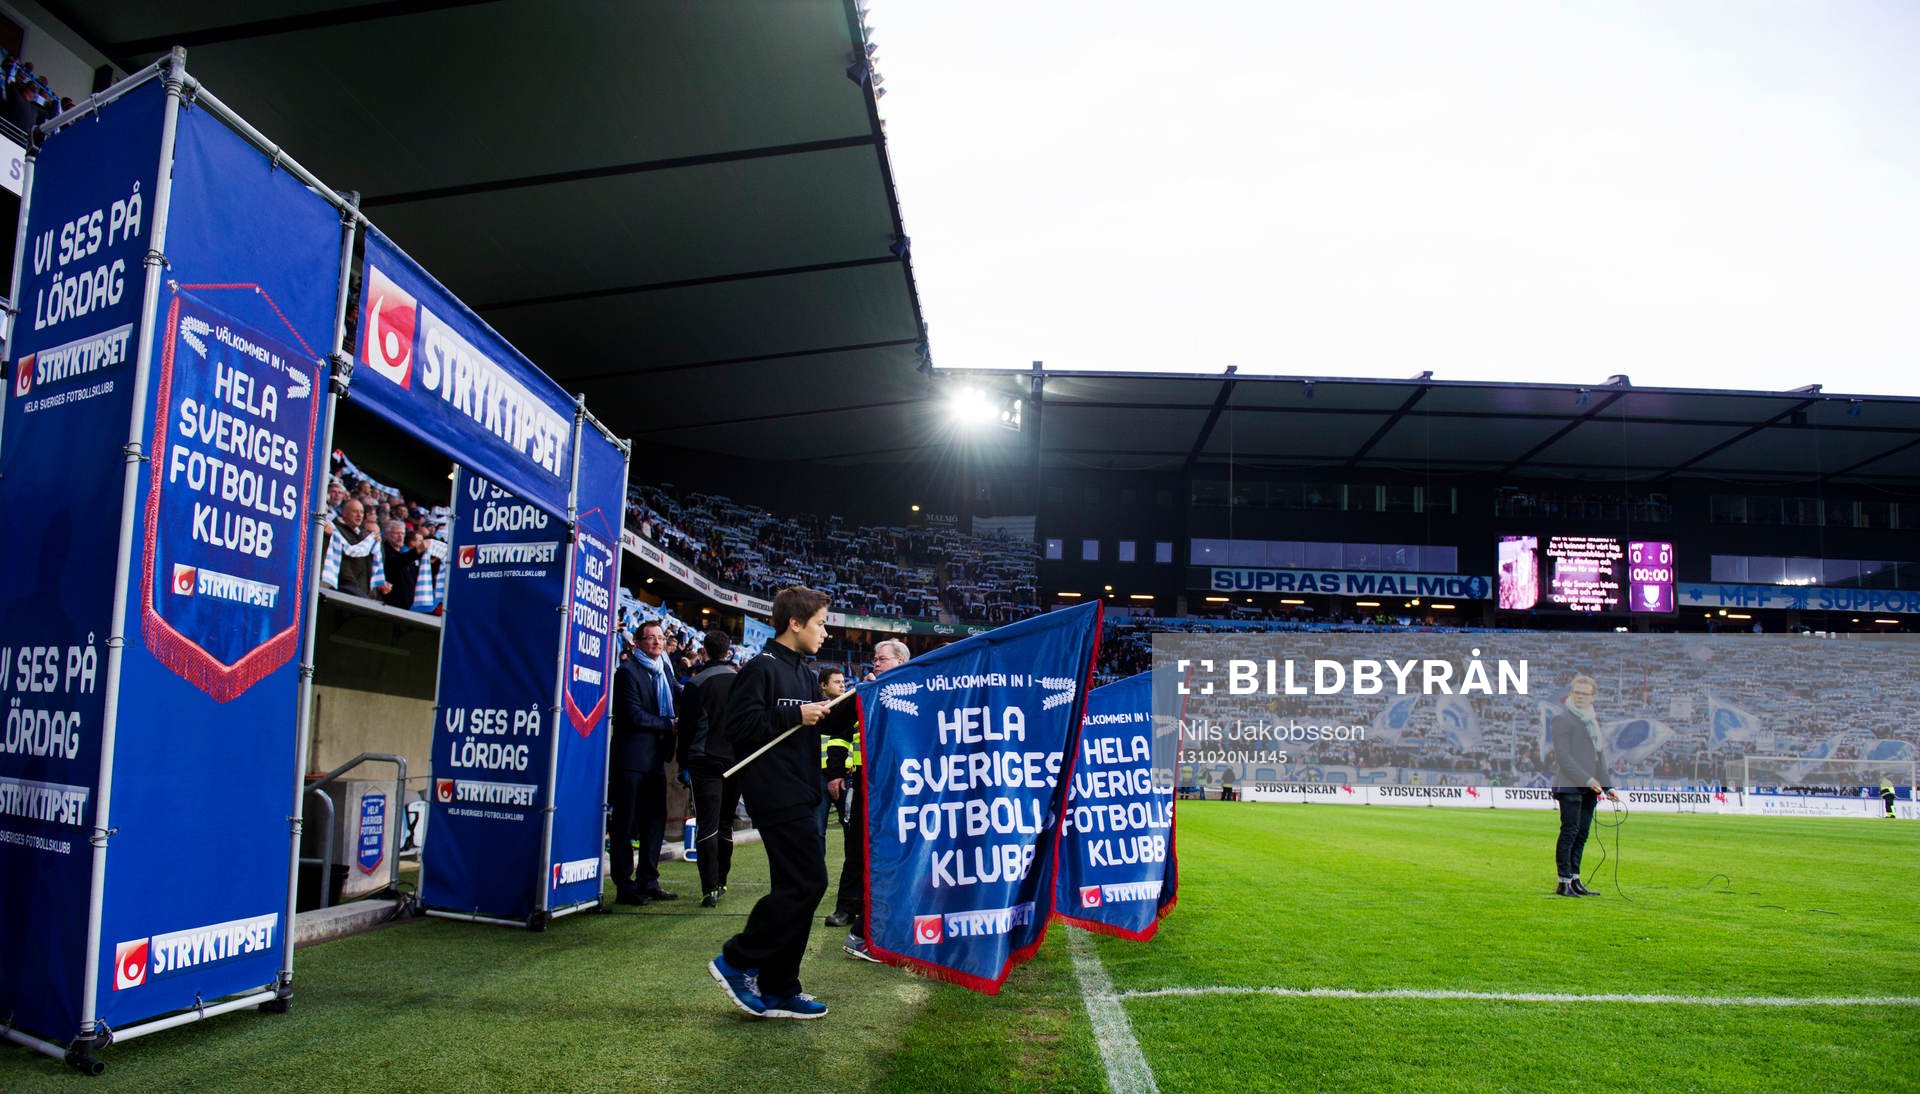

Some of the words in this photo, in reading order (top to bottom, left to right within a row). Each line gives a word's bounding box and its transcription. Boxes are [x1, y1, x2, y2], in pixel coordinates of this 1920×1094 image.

[34, 229, 54, 276] VI
[58, 208, 104, 267] SES
[107, 180, 143, 247] PÅ
[34, 258, 126, 331] LÖRDAG
[36, 330, 131, 386] STRYKTIPSET
[215, 326, 271, 368] VÄLKOMMEN
[271, 355, 281, 370] IN
[24, 400, 39, 413] HELA
[39, 394, 66, 410] SVERIGES
[66, 380, 114, 403] FOTBOLLSKLUBB
[215, 361, 278, 422] HELA
[422, 326, 567, 478] STRYKTIPSET
[178, 397, 299, 477] SVERIGES
[170, 444, 298, 521] FOTBOLLS
[192, 501, 274, 559] KLUBB
[477, 545, 558, 564] STRYKTIPSET
[585, 553, 603, 582] HELA
[1633, 550, 1641, 564] 0
[1660, 551, 1668, 564] 0
[198, 574, 278, 608] STRYKTIPSET
[1214, 570, 1340, 593] SUPRAS
[1346, 574, 1466, 597] MALMÖ
[1633, 568, 1669, 582] 00:00
[575, 575, 609, 610] SVERIGES
[1719, 586, 1774, 608] MFF
[572, 601, 608, 635] FOTBOLLS
[578, 630, 600, 658] KLUBB
[16, 646, 60, 693] SES
[65, 631, 97, 693] PÅ
[926, 672, 1007, 692] VÄLKOMMEN
[1010, 673, 1023, 688] IN
[0, 697, 81, 760] ÖRDAG
[445, 708, 465, 733] VI
[470, 708, 508, 735] SES
[513, 703, 541, 736] PÅ
[937, 705, 1026, 745] HELA
[1134, 712, 1144, 722] IN
[450, 736, 529, 771] LÖRDAG
[1083, 735, 1151, 766] HELA
[900, 751, 1064, 796] SVERIGES
[1255, 782, 1337, 794] SYDSVENSKAN
[456, 783, 537, 806] STRYKTIPSET
[1380, 786, 1462, 798] SYDSVENSKAN
[1629, 793, 1710, 804] SYDSVENSKAN
[460, 808, 483, 818] SVERIGES
[484, 810, 524, 821] FOTBOLLSKLUBB
[25, 834, 71, 854] FOTBOLLSKLUBB
[1088, 835, 1166, 867] KLUBB
[932, 843, 1036, 888] KLUBB
[153, 919, 275, 975] STRYKTIPSET
